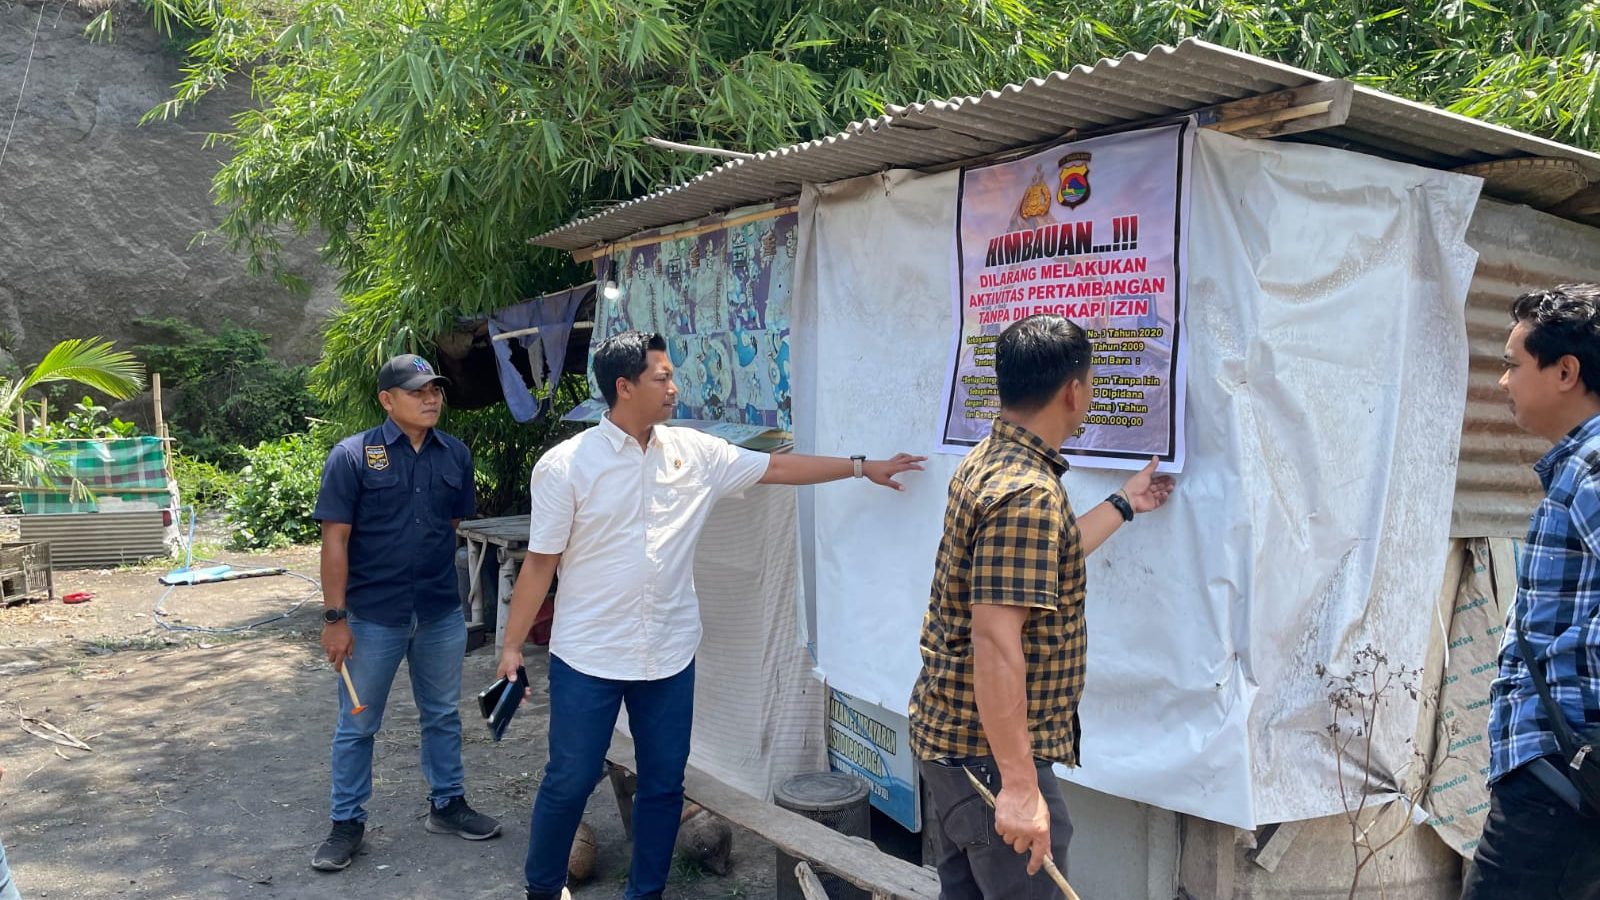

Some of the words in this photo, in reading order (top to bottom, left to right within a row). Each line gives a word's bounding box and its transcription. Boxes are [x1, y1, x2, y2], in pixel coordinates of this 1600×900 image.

[979, 267, 1037, 288] DILARANG
[1041, 257, 1147, 279] MELAKUKAN
[969, 287, 1024, 308] AKTIVITAS
[1028, 278, 1165, 301] PERTAMBANGAN
[978, 308, 1010, 325] TANPA
[1013, 302, 1106, 321] DILENGKAPI
[1110, 300, 1149, 316] IZIN
[1108, 328, 1136, 338] Tahun
[1139, 328, 1163, 337] 2020
[1094, 342, 1119, 352] Tahun
[1120, 341, 1145, 351] 2009
[1108, 355, 1131, 365] Bara
[1111, 376, 1141, 387] Tanpa
[1143, 376, 1160, 386] Izin
[1101, 388, 1144, 400] Dipidana
[1118, 403, 1148, 413] Tahun
[1083, 415, 1144, 428] 0.000.000,00
